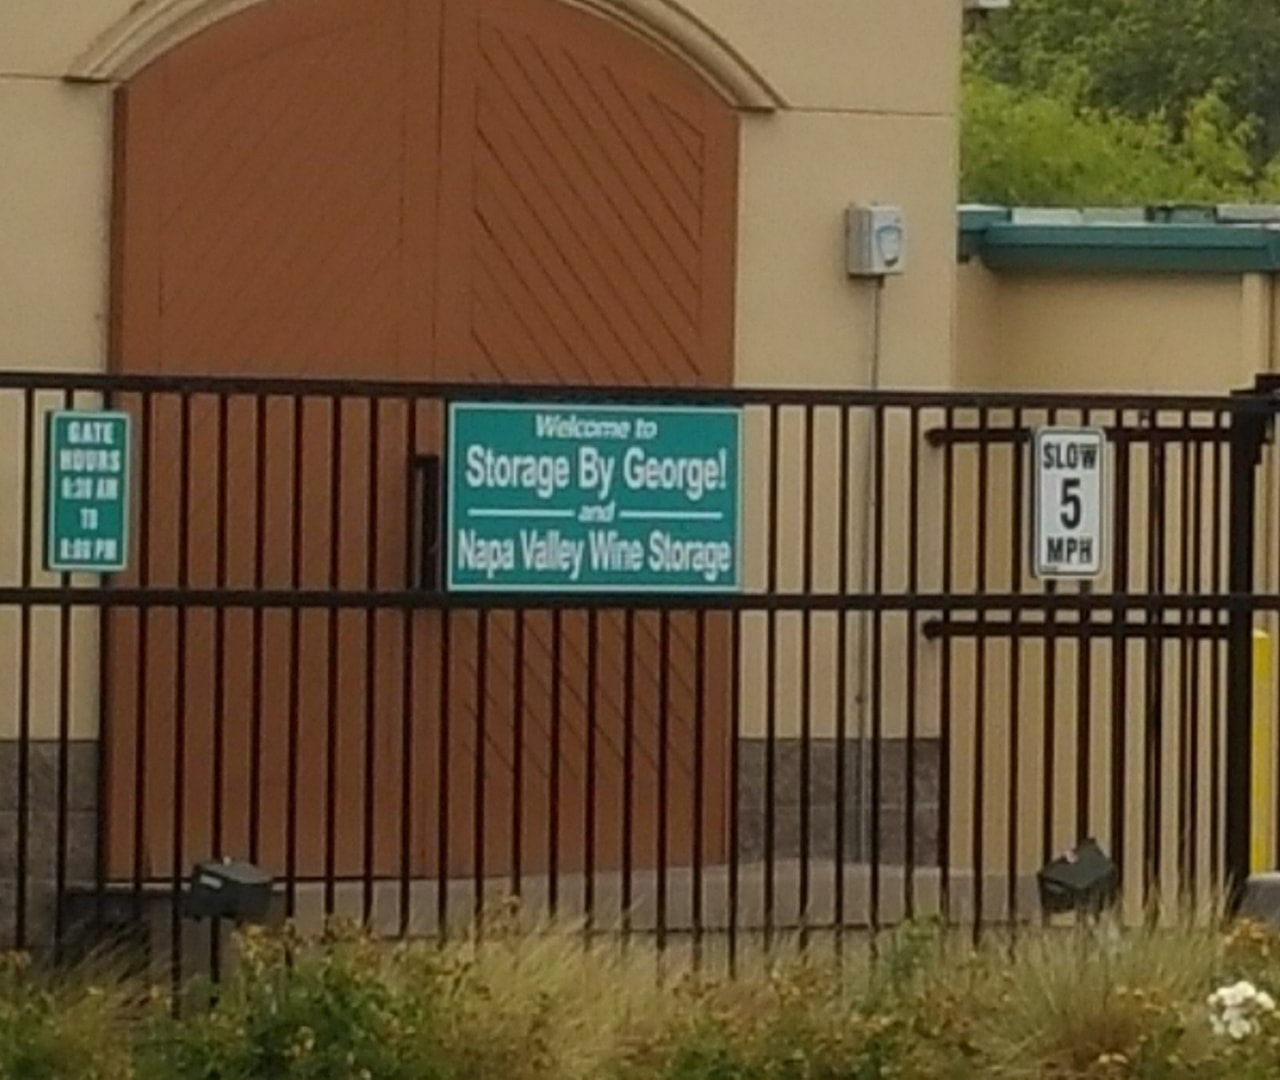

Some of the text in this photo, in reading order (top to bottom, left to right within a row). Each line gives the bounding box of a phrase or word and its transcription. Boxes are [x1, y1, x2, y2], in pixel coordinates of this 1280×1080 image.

[67, 421, 115, 444] GATE
[534, 414, 658, 440] Welcome to
[60, 449, 121, 472] HOURS
[1043, 441, 1098, 469] SLOW
[466, 445, 727, 501] Storage By George!
[578, 500, 616, 522] and
[1060, 477, 1082, 530] 5
[80, 508, 99, 530] TO
[457, 529, 732, 582] Napa Valley Wine Storage
[1047, 536, 1093, 564] MPH
